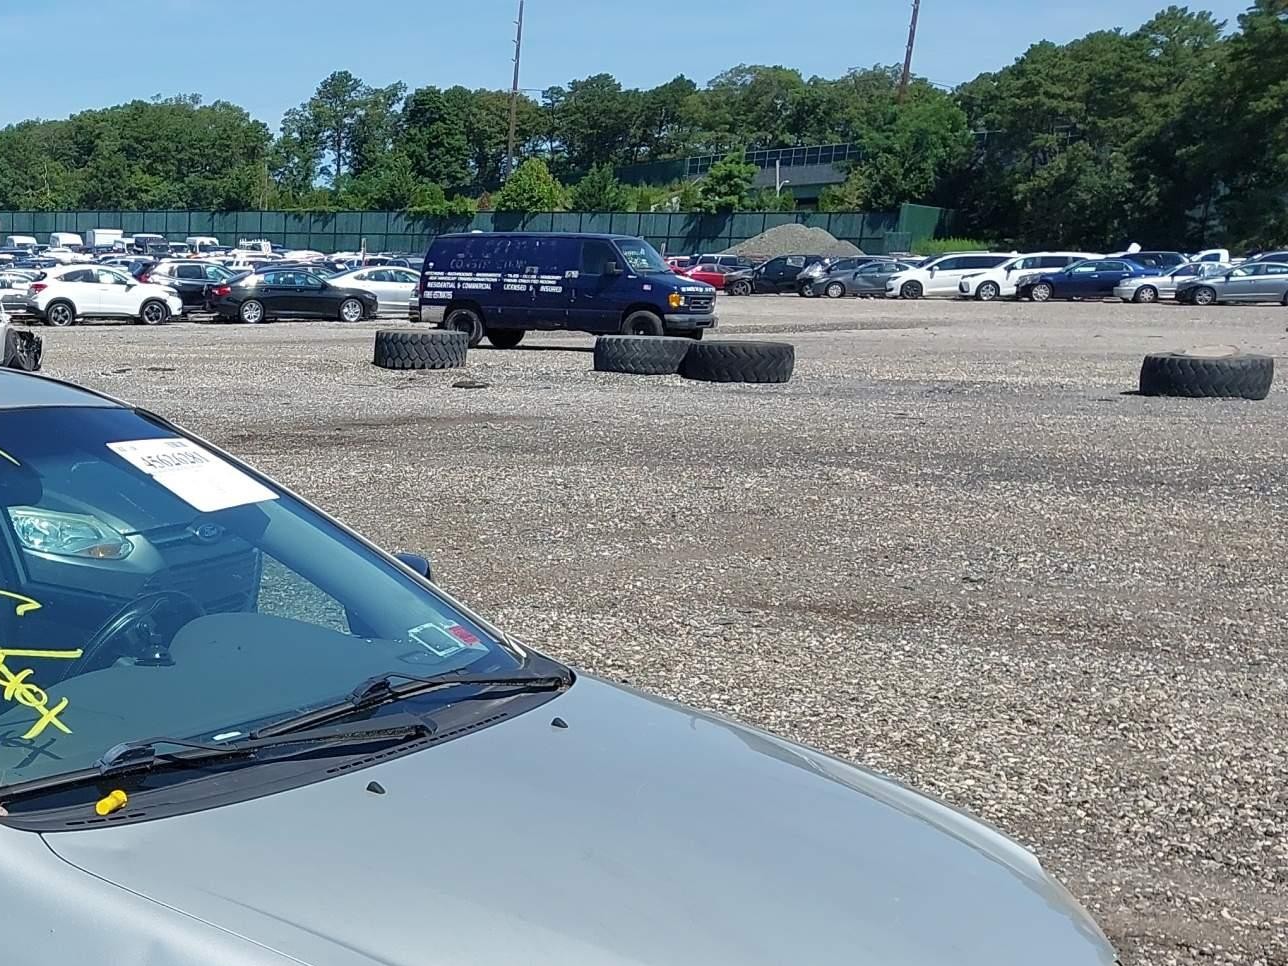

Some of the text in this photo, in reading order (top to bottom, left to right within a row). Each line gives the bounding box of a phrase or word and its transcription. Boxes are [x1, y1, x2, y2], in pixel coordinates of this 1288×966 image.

[427, 281, 455, 289] RESIDENTIAL
[462, 282, 492, 290] COMMERCIAL
[539, 285, 563, 293] INSURED
